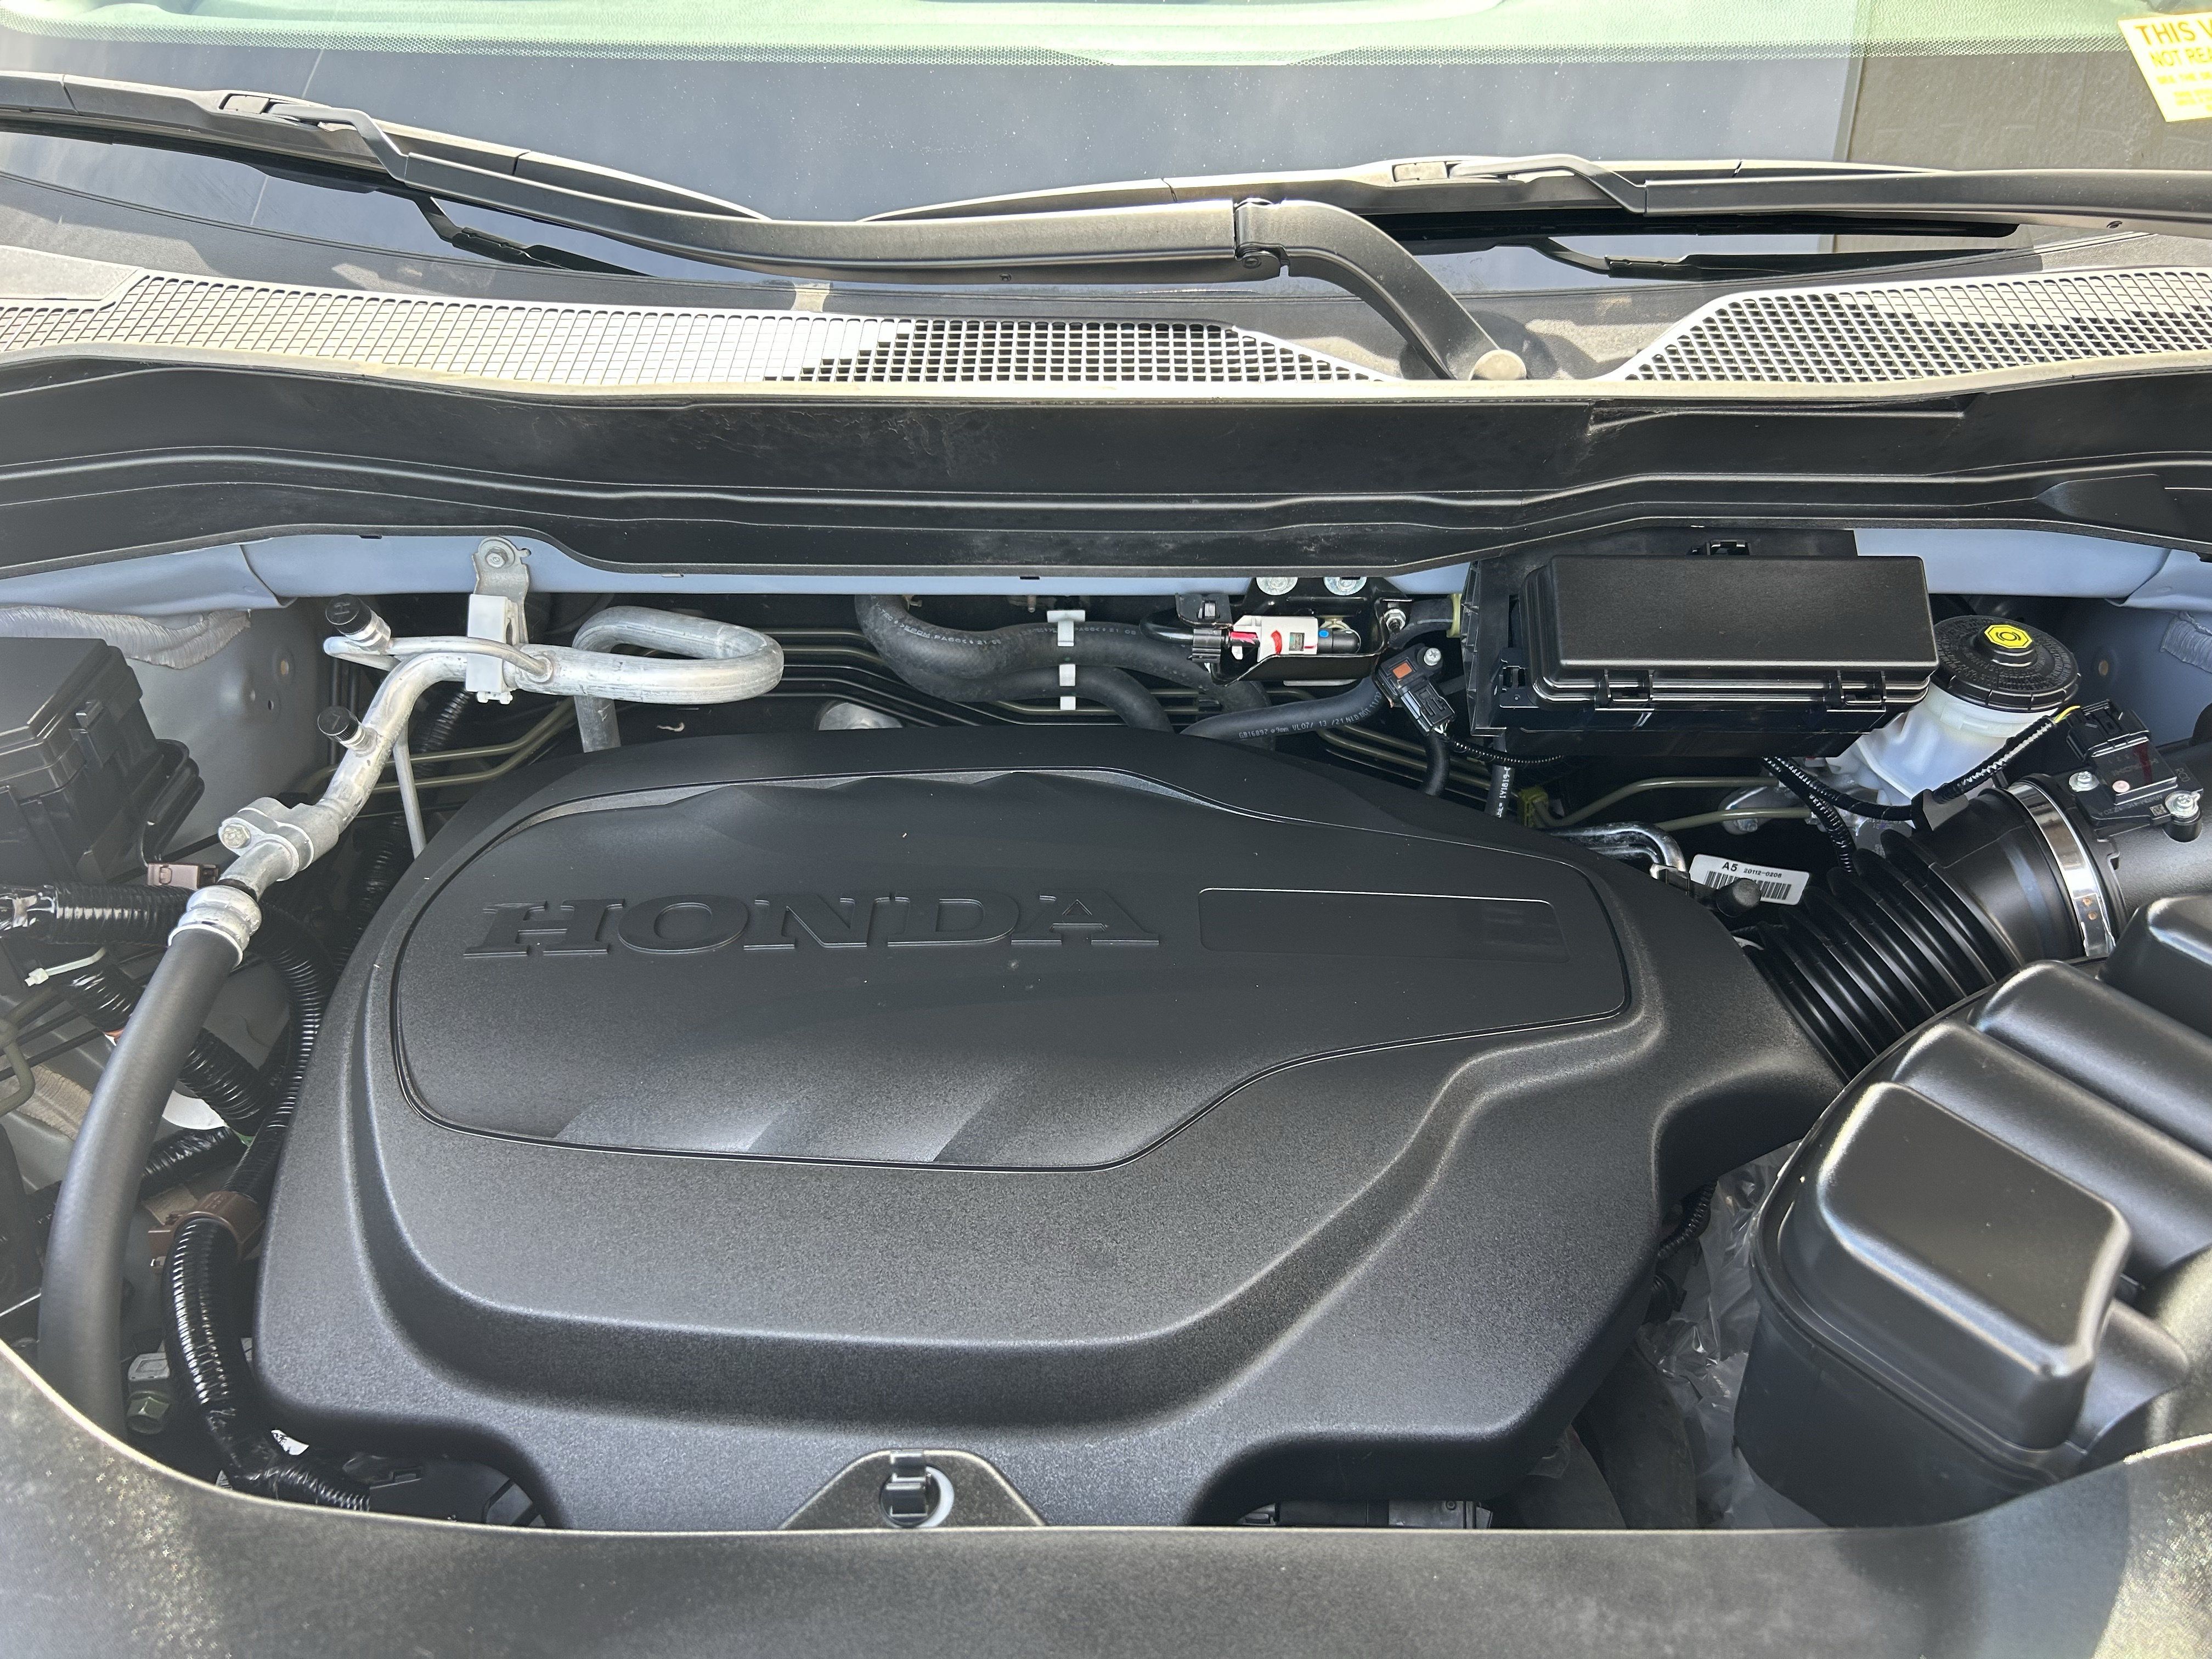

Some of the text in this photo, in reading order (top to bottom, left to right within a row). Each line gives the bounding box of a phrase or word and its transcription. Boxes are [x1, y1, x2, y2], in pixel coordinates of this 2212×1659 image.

[2134, 21, 2196, 46] THIS
[2149, 50, 2182, 67] NOT
[1722, 861, 1739, 872] A5
[464, 890, 1160, 958] HONDA
